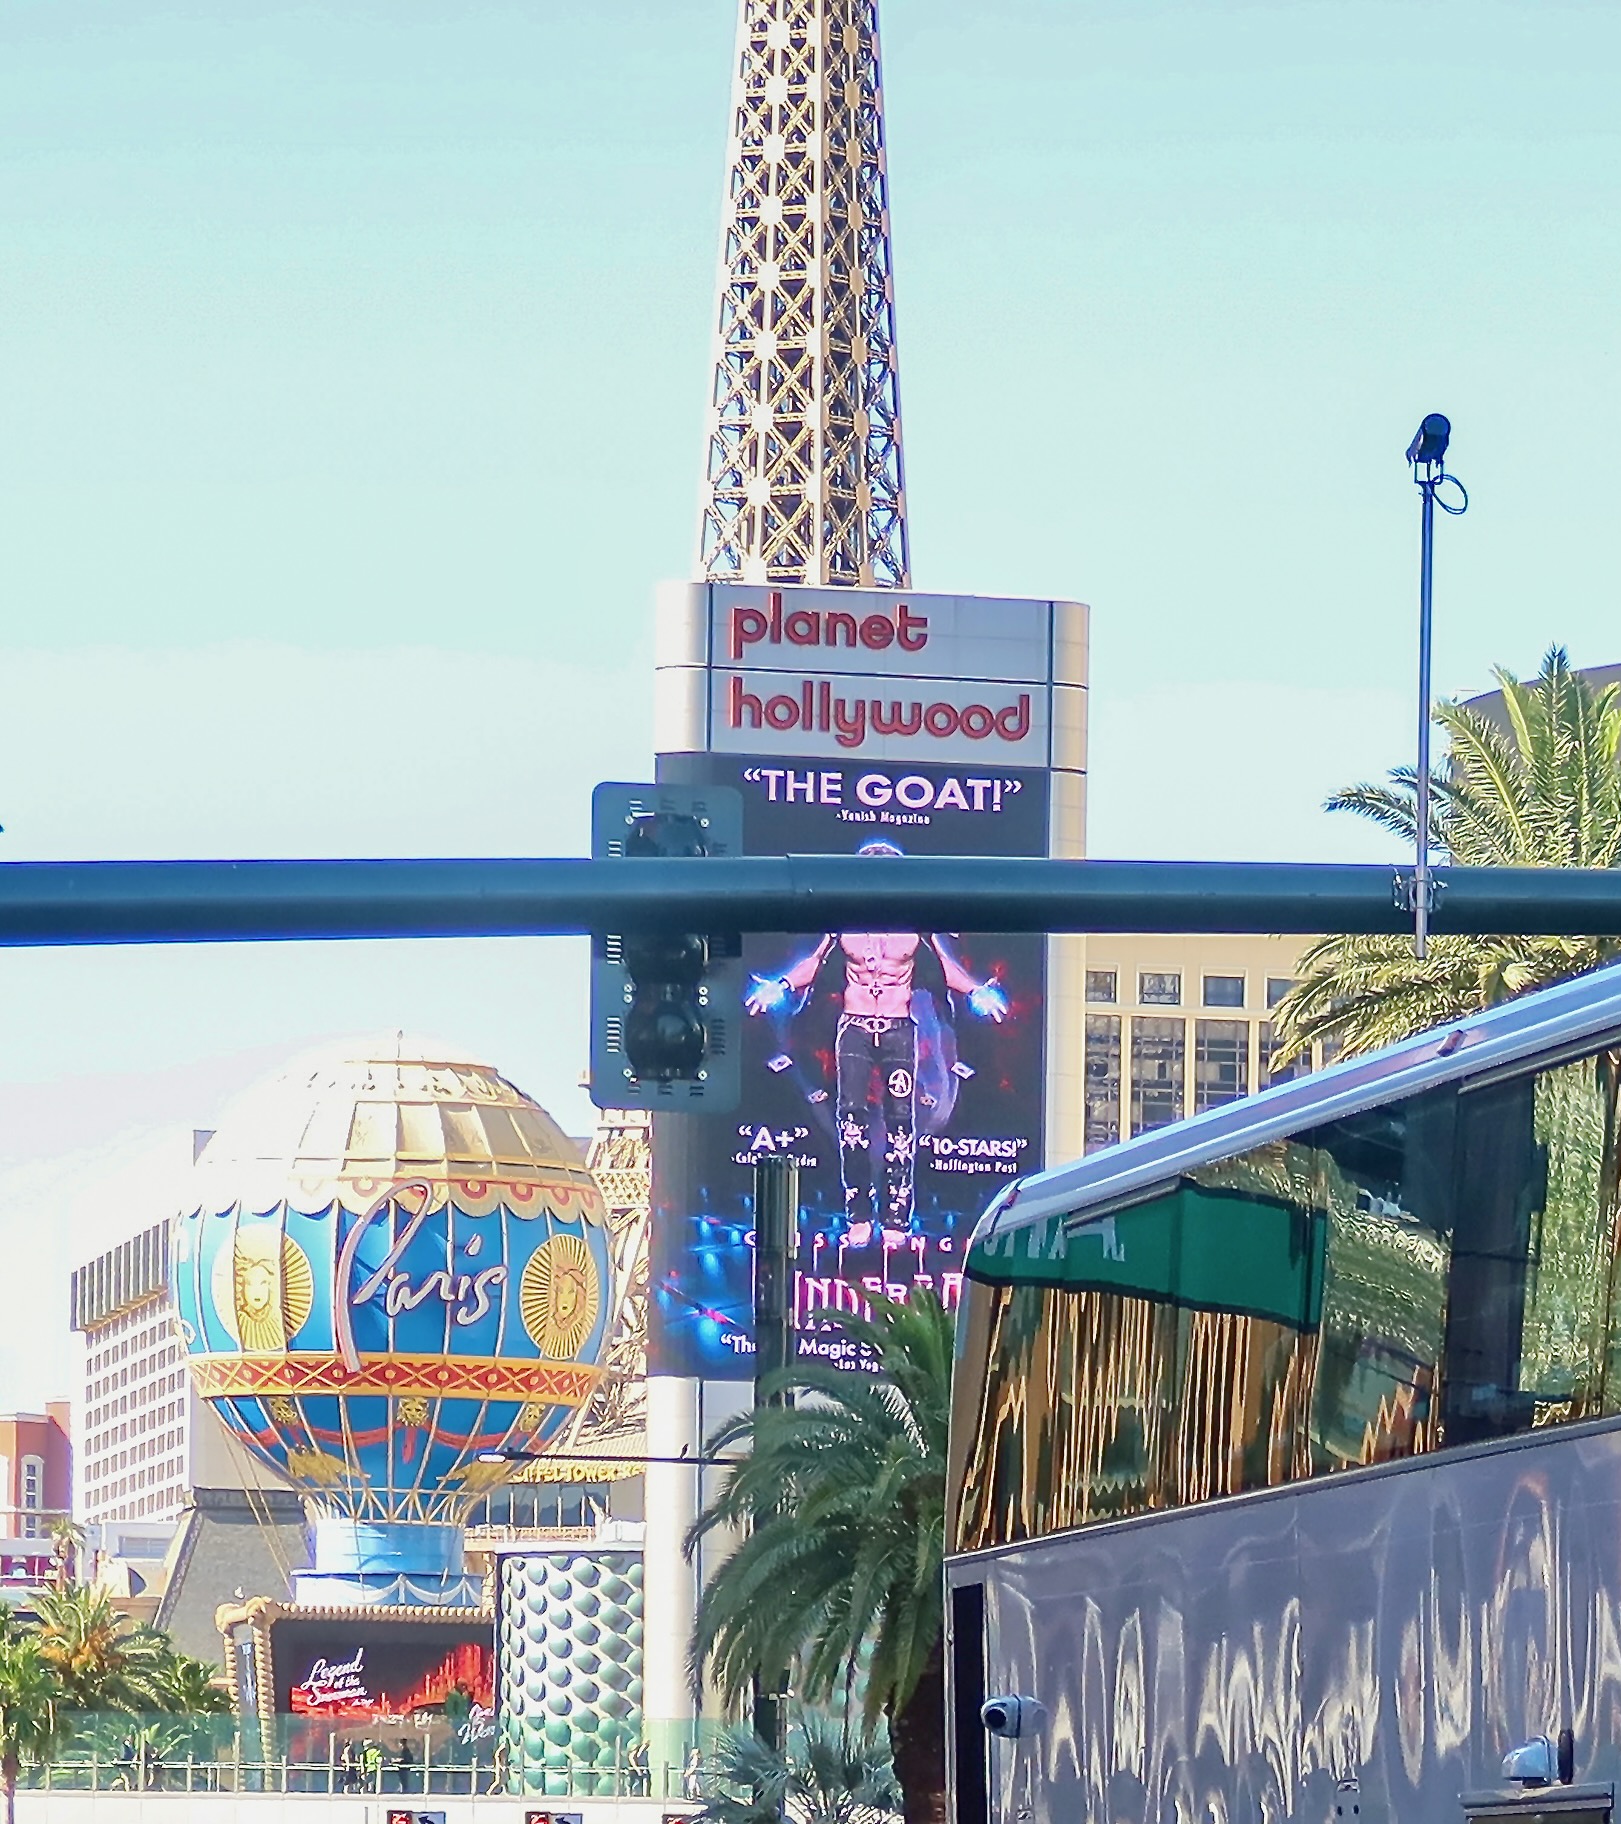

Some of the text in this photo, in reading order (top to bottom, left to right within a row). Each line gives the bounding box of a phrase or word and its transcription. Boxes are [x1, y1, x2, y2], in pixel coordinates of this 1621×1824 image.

[730, 592, 928, 660] planet
[730, 676, 1031, 748] hollywood
[334, 1177, 508, 1374] Paris
[798, 1338, 857, 1360] Magic
